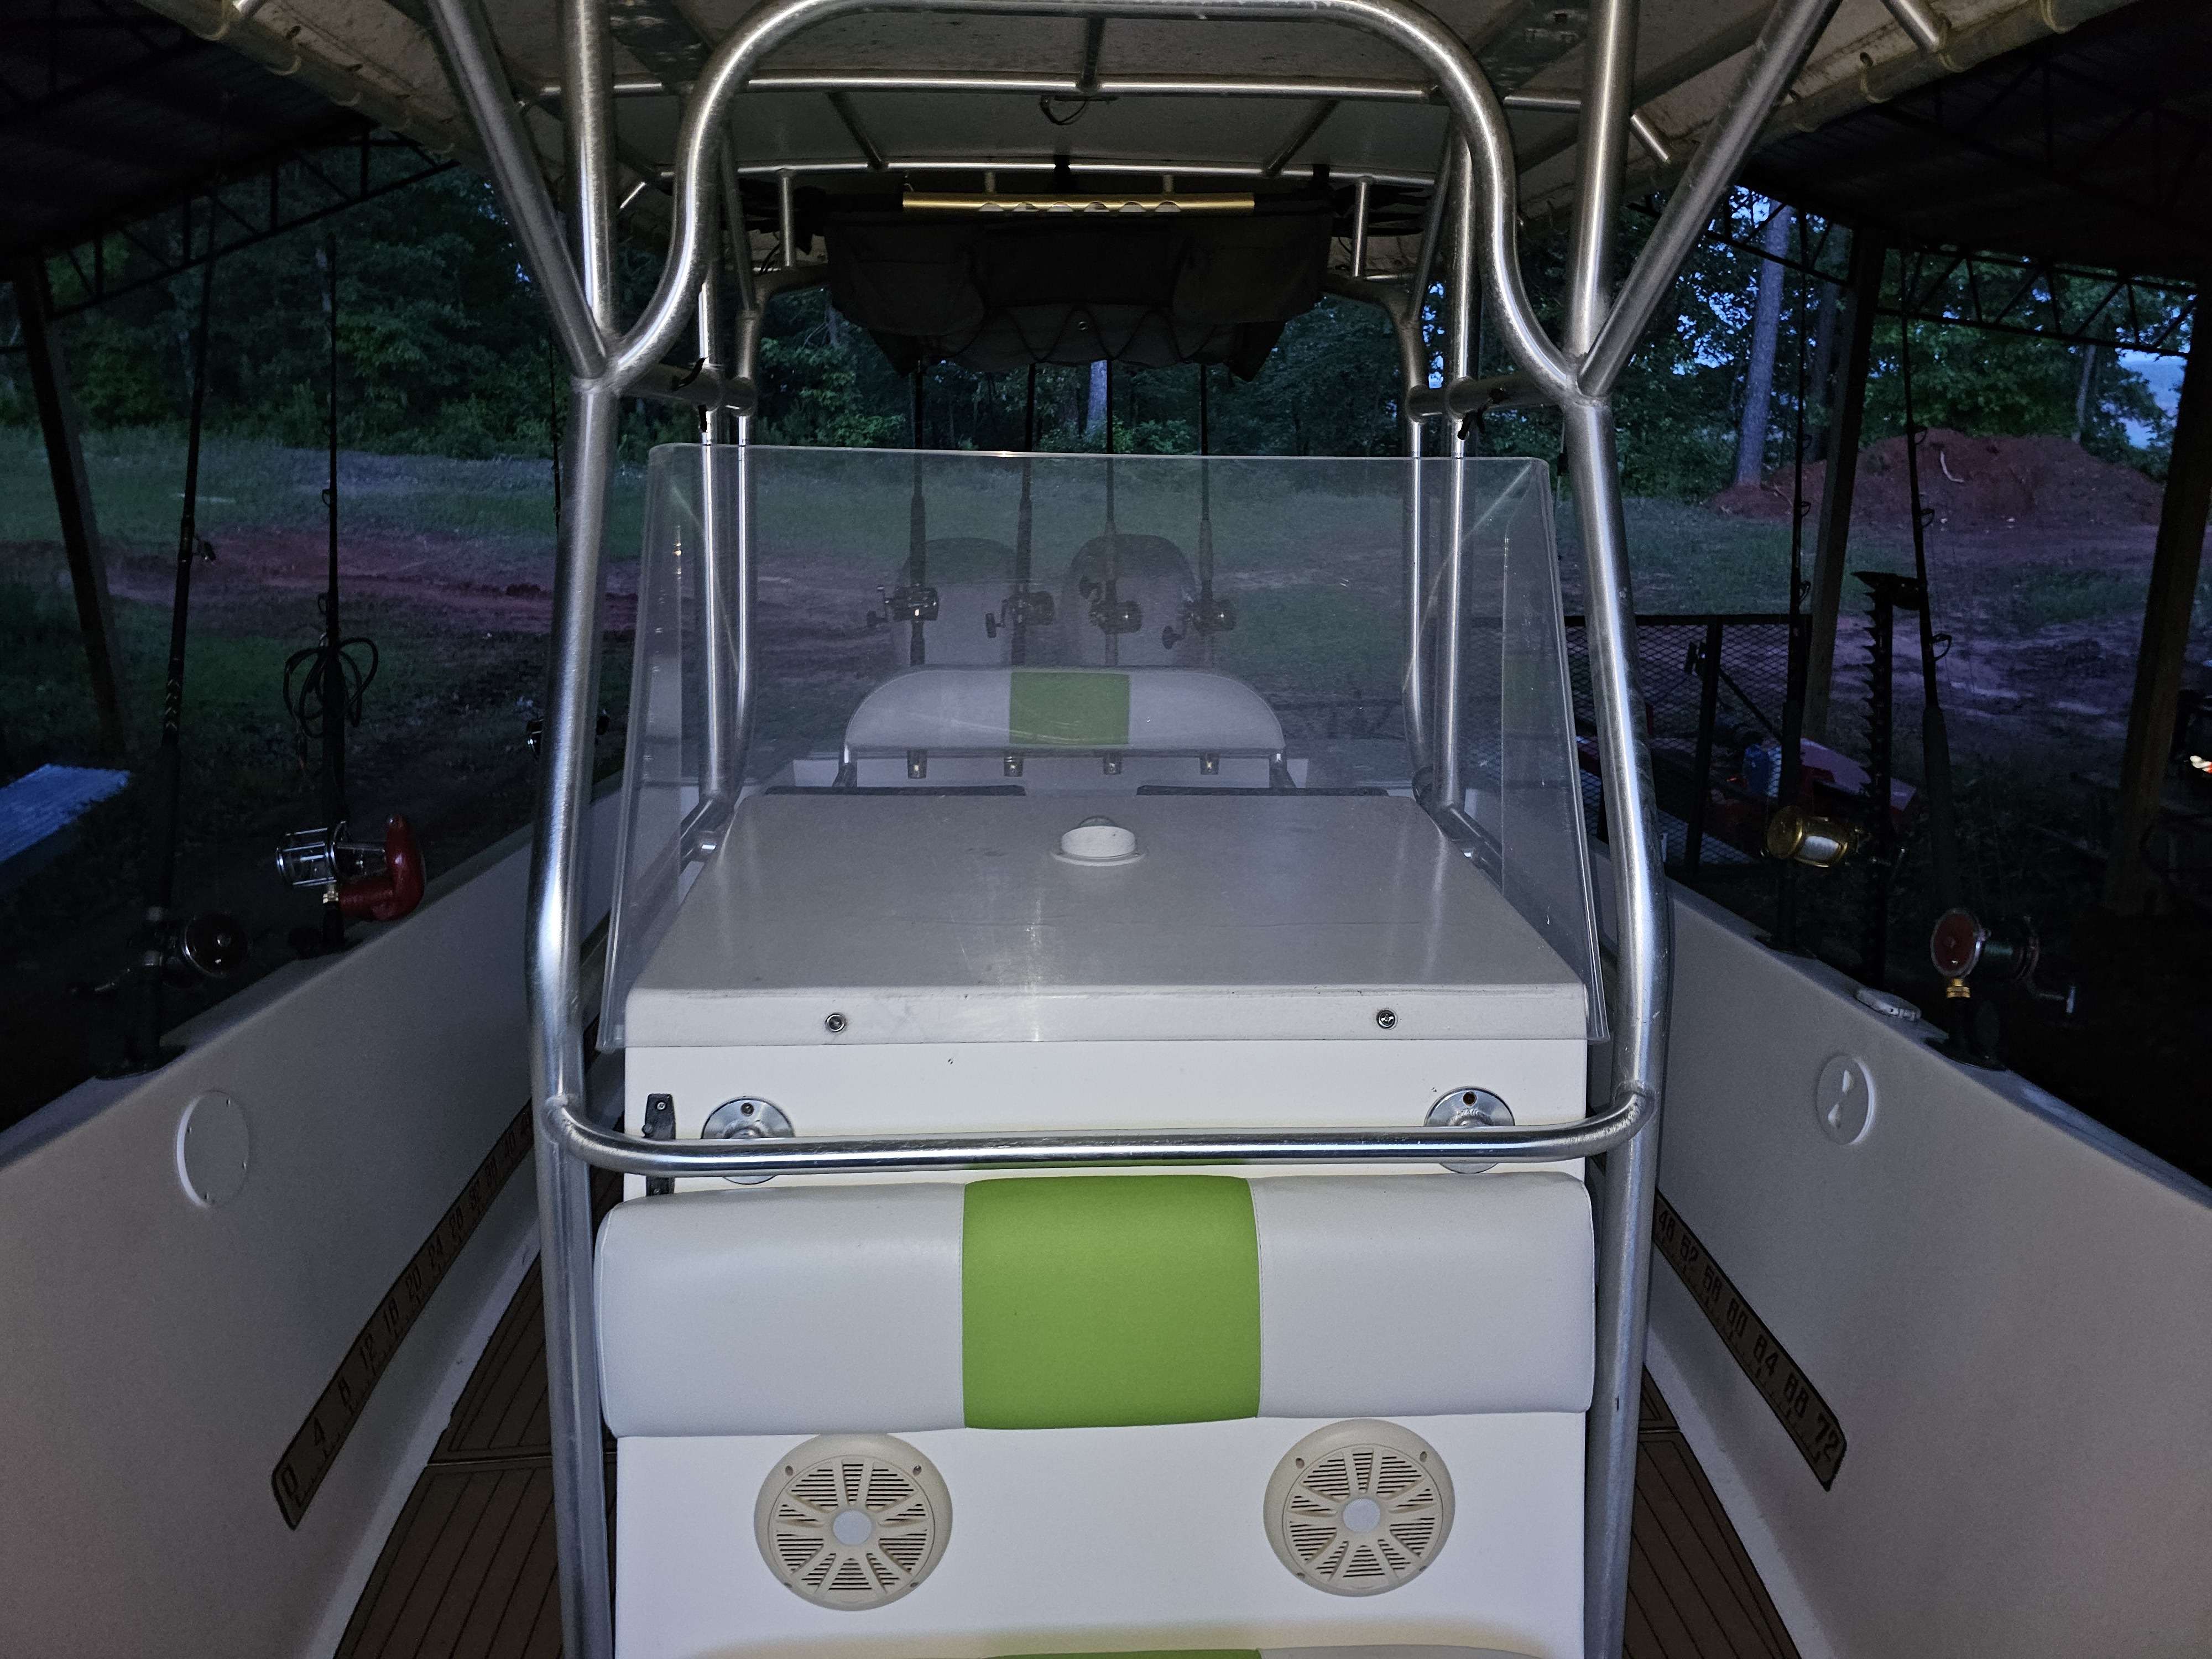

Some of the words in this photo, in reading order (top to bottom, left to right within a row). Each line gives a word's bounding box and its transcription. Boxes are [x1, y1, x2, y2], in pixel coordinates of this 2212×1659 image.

[281, 1464, 299, 1500] 0
[314, 1417, 326, 1446] 4
[405, 1265, 421, 1301] 20
[1815, 1412, 1840, 1461] 72
